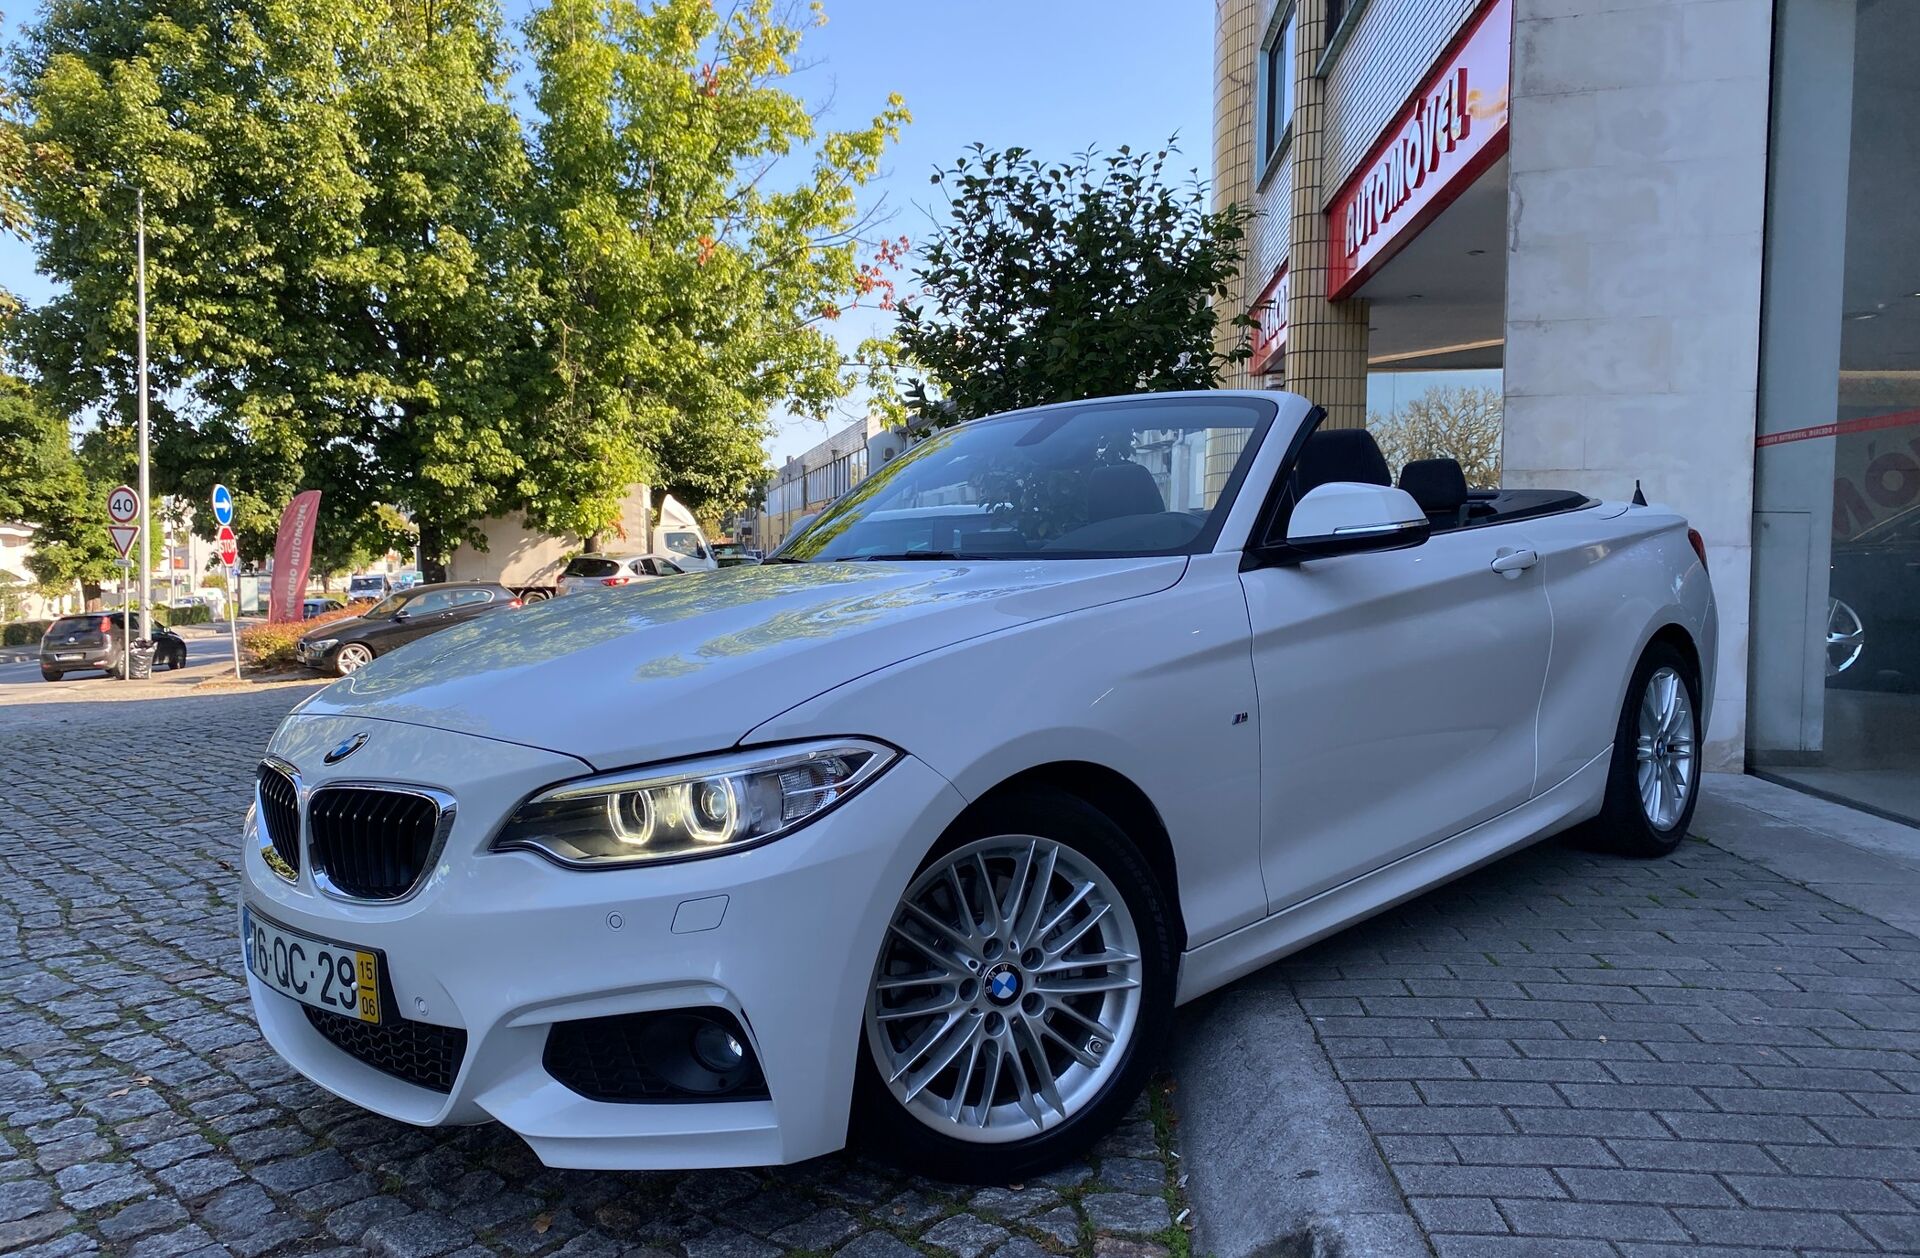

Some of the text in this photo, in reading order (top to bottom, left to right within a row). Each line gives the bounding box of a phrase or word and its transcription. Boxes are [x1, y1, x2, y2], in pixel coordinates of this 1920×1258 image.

[1345, 67, 1471, 259] AUTOMÓVEL
[112, 498, 133, 512] 40
[219, 539, 236, 553] STOP
[360, 960, 373, 980] 15
[985, 963, 1009, 994] BMW
[362, 996, 376, 1017] 06
